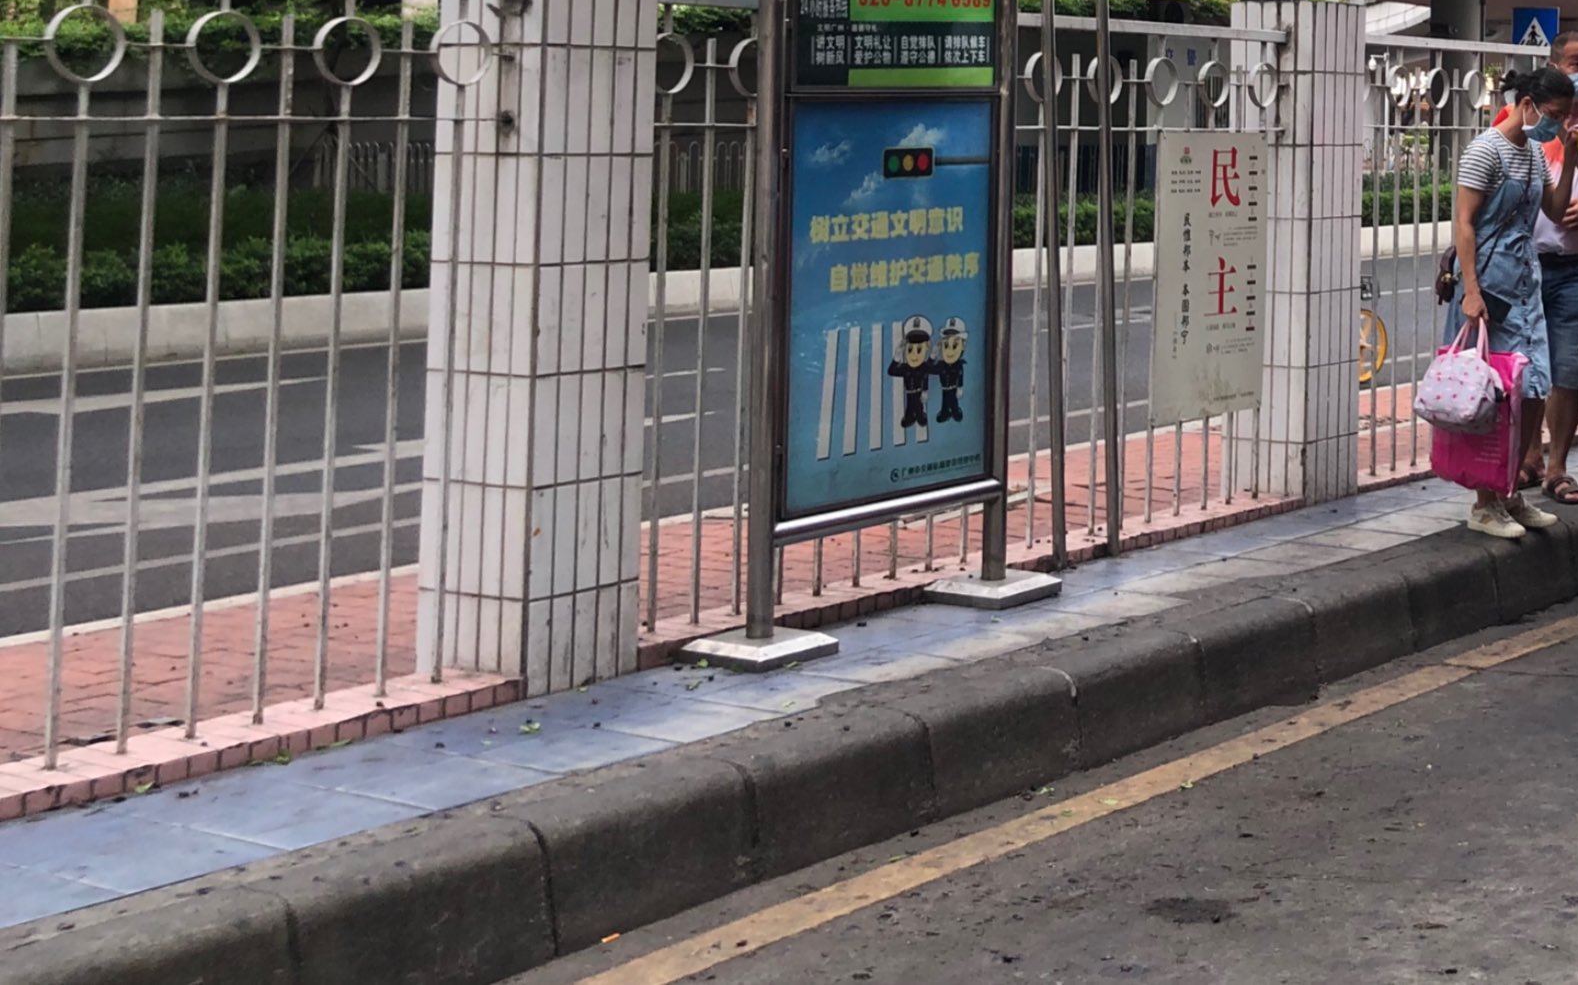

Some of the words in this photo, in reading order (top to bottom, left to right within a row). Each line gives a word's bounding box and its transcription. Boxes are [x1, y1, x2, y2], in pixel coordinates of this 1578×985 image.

[1210, 146, 1241, 209] 民
[810, 206, 964, 244] 树立交通文明意识
[830, 252, 980, 293] 自觉维护交通秩序
[1204, 257, 1238, 317] 主
